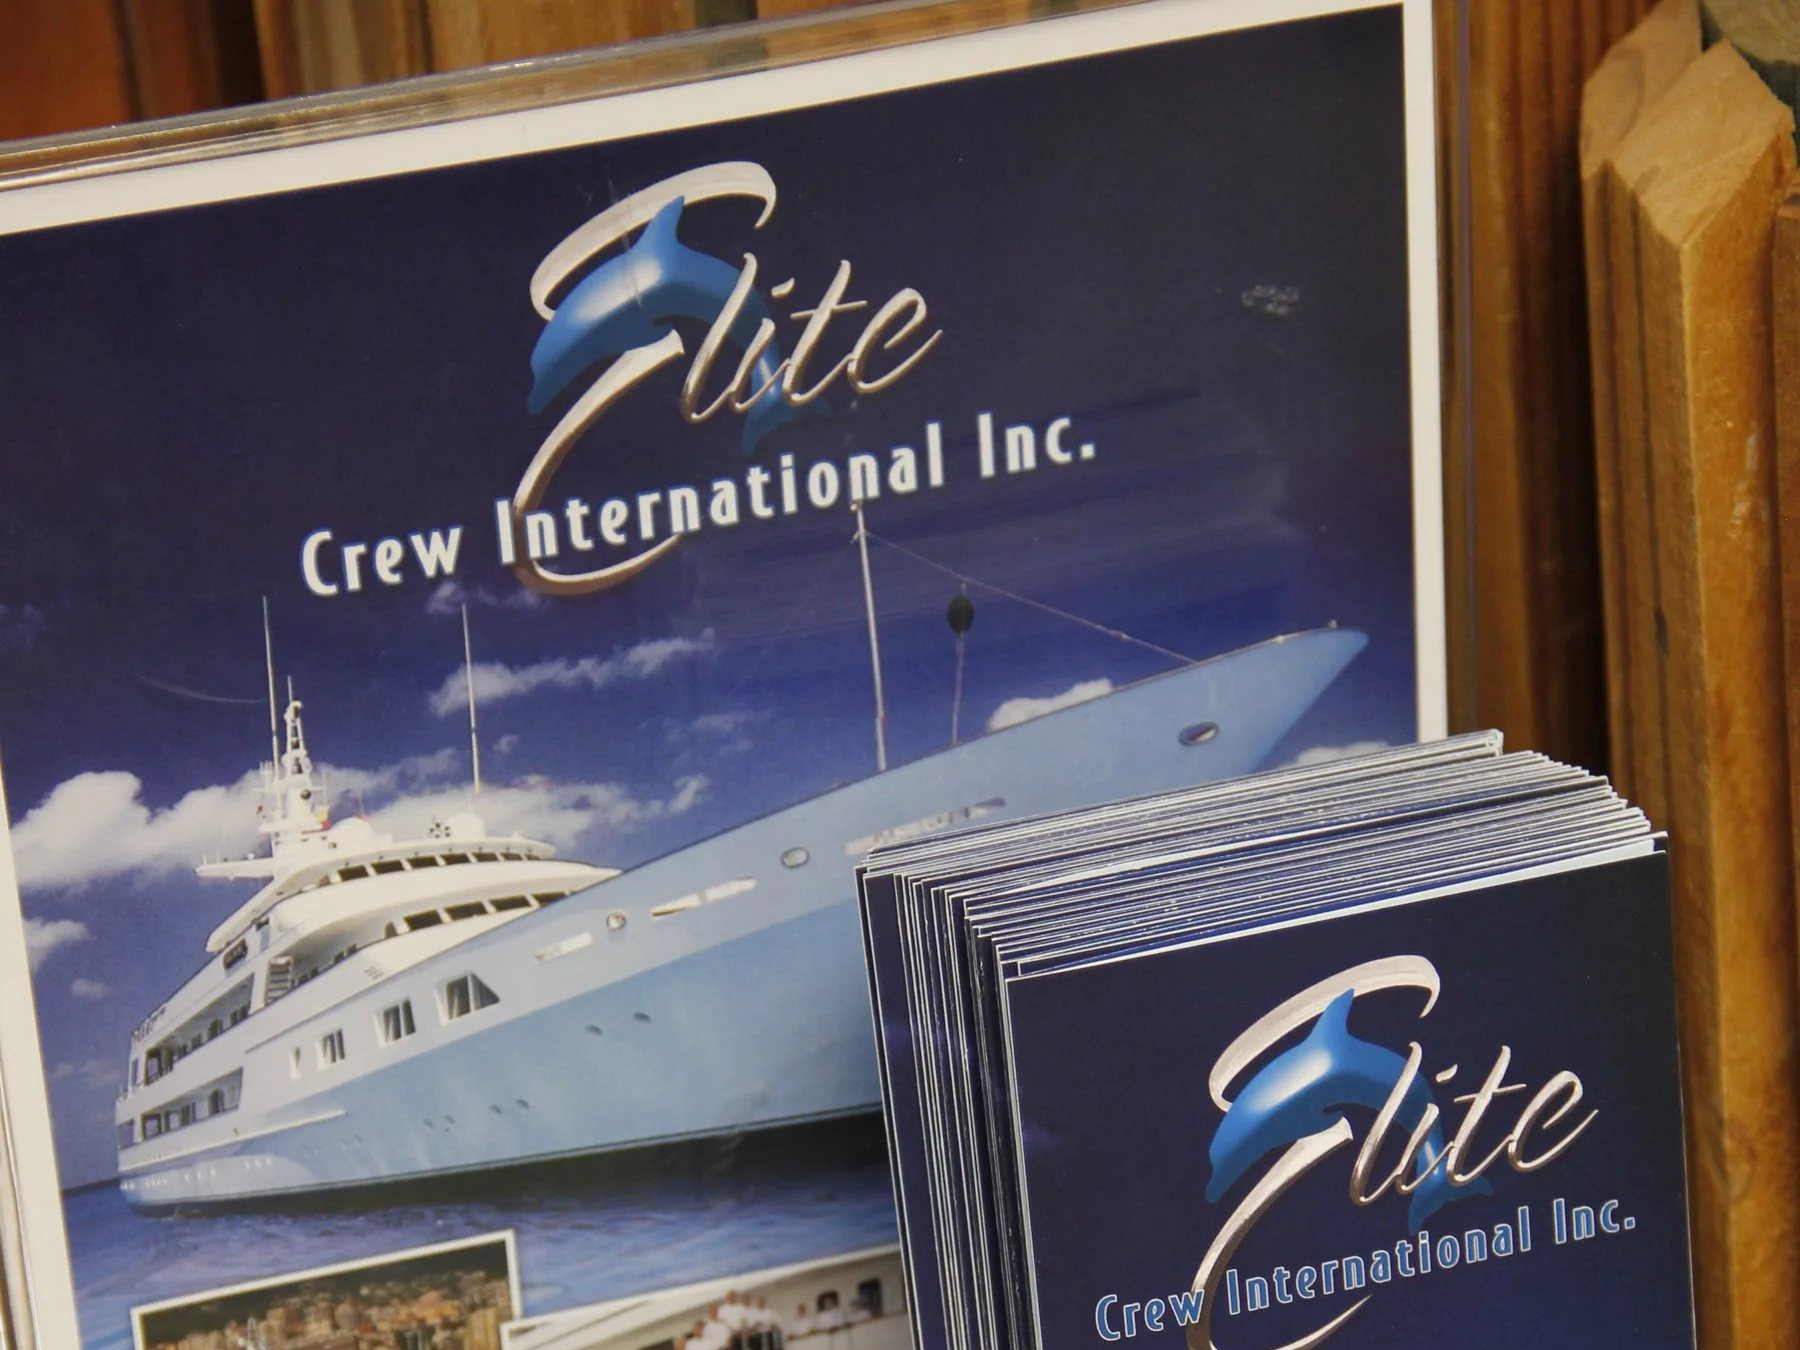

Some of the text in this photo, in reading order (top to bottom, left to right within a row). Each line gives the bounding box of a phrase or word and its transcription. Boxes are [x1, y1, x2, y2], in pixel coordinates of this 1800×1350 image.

[514, 160, 943, 594] Elite
[301, 411, 1097, 597] Crew International Inc.
[1095, 1197, 1637, 1342] Crew International Inc.
